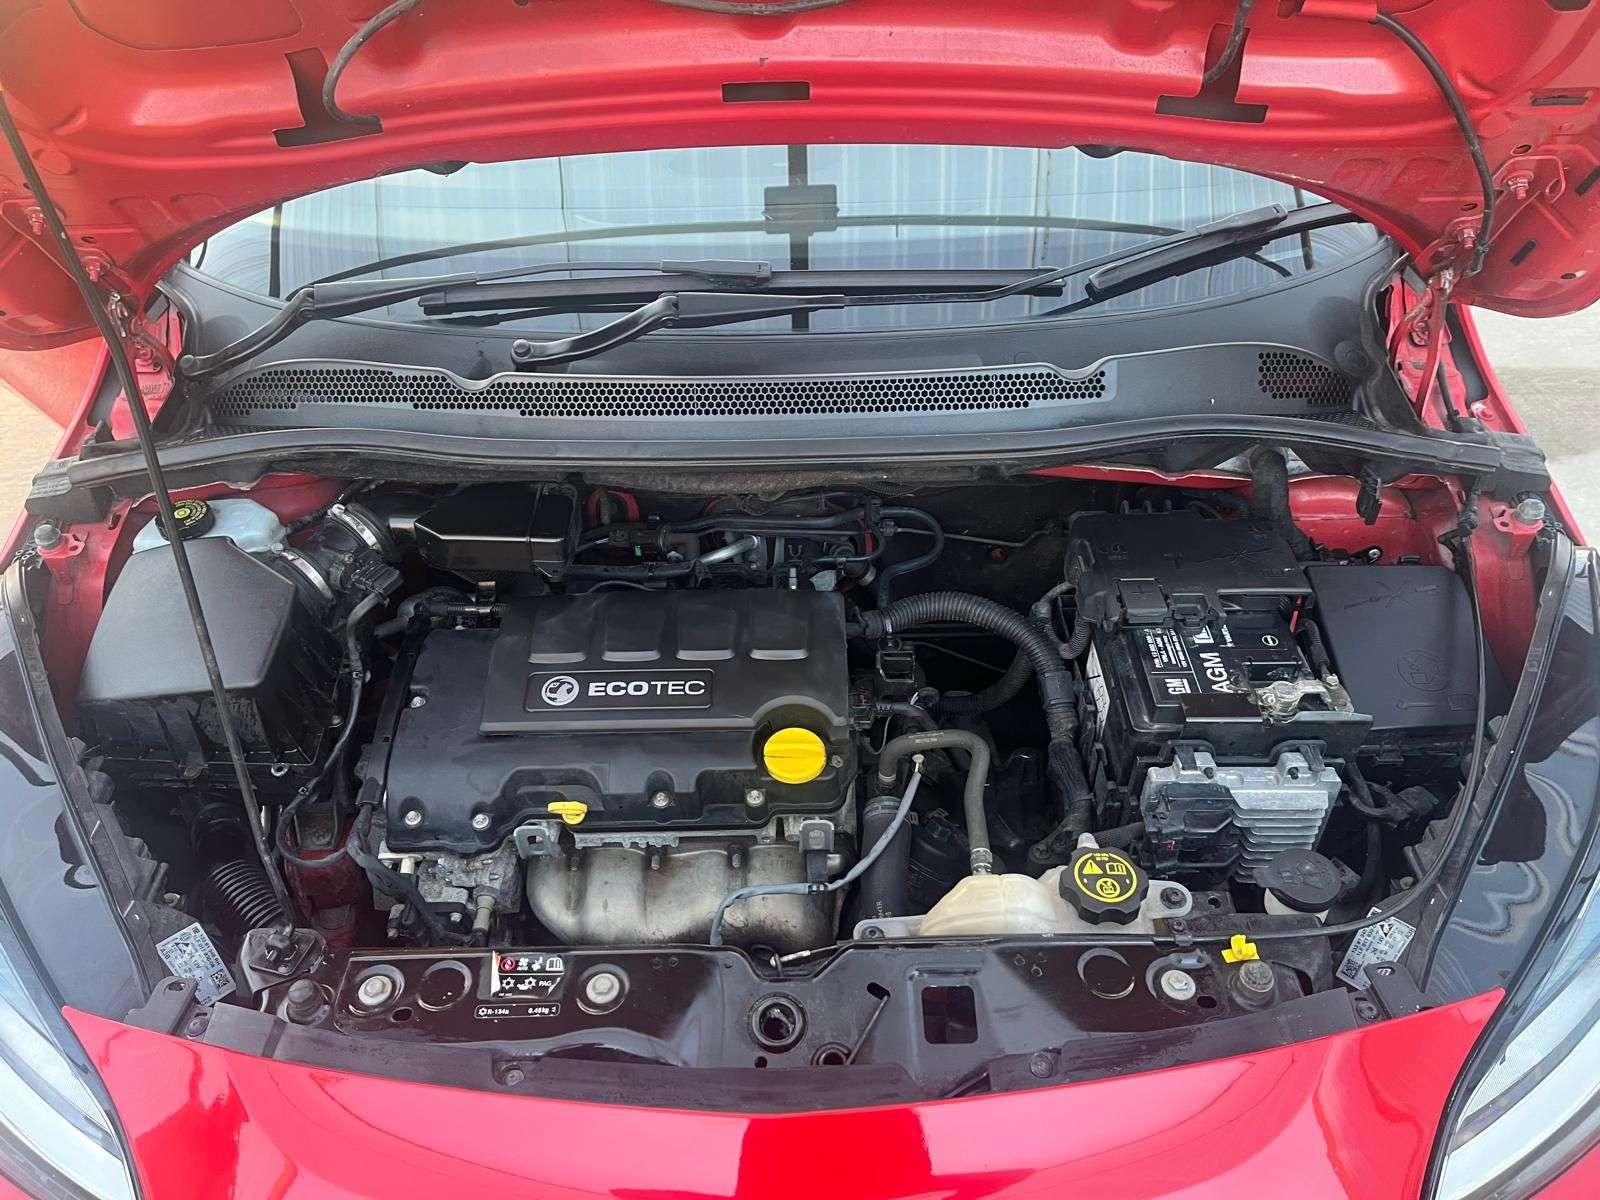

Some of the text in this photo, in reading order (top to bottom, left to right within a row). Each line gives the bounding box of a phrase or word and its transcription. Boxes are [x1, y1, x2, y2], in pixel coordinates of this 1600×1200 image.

[1199, 652, 1234, 694] AGM
[587, 680, 706, 697] ECOTEC
[1164, 678, 1186, 695] GM
[538, 980, 552, 988] PAG
